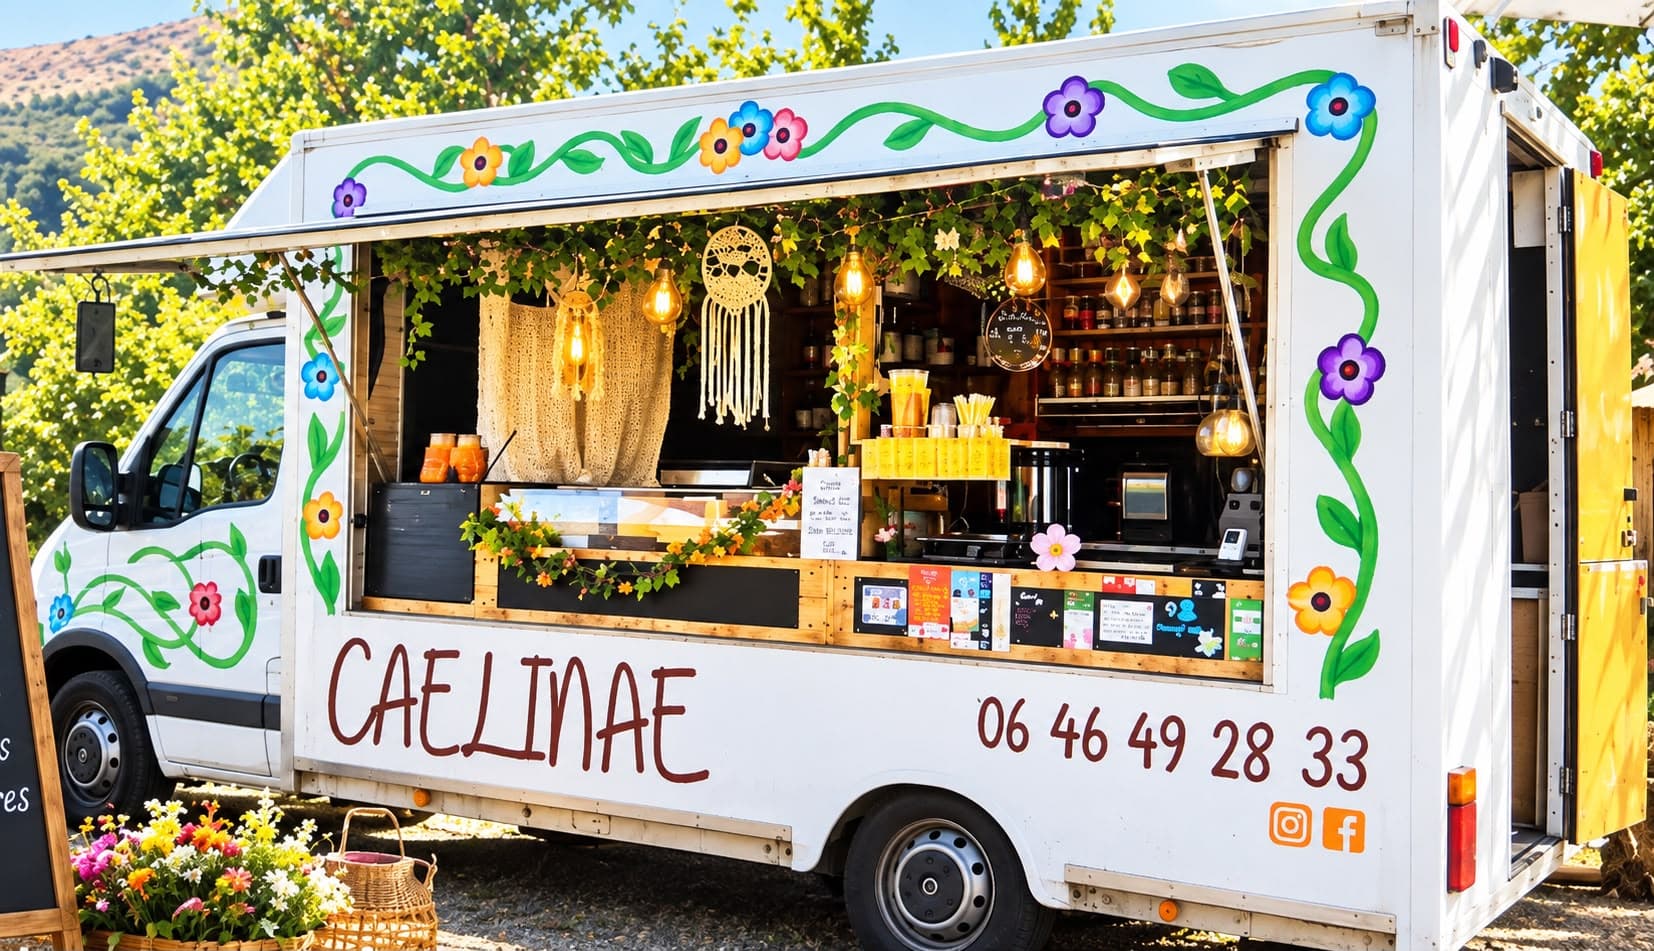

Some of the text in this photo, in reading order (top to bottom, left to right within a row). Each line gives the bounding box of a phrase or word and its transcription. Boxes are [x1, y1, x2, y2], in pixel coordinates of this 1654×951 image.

[328, 637, 710, 784] CAELINAE
[978, 696, 1369, 792] 06 46 49 28 33
